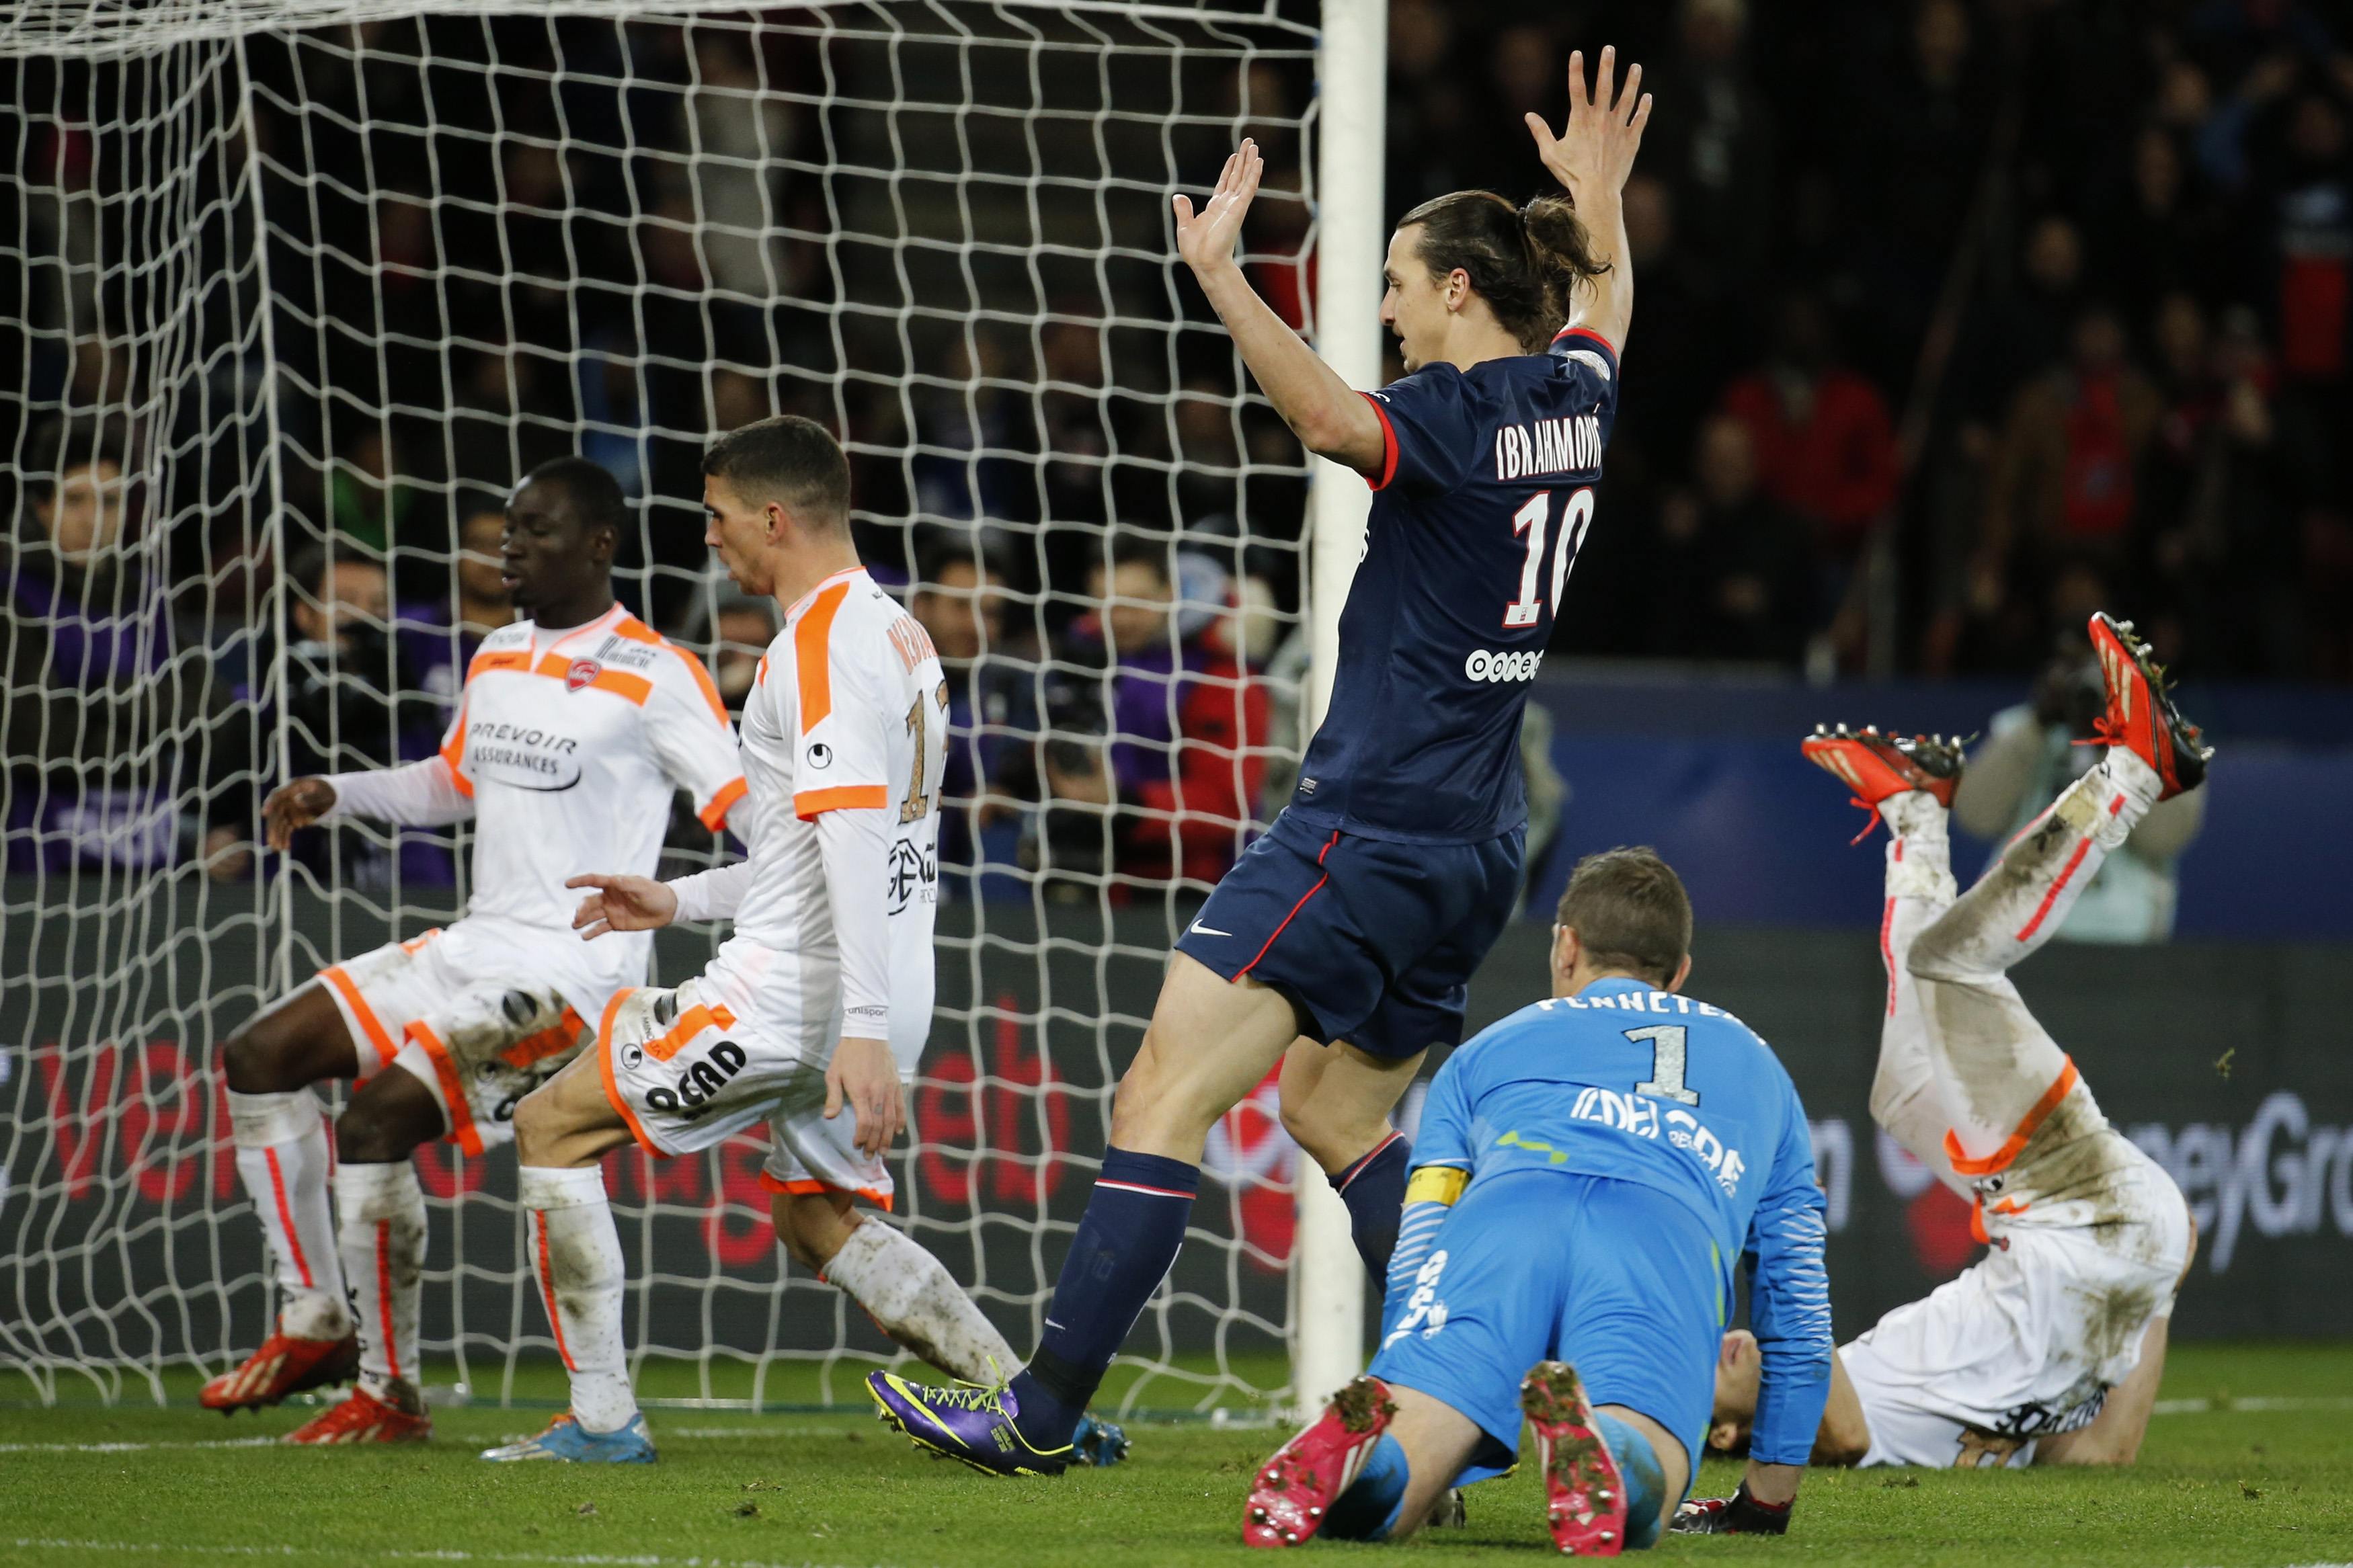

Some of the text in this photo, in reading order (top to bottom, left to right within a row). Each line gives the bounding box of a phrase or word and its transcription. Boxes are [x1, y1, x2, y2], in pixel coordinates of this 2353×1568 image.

[1502, 486, 1595, 629] 10
[472, 745, 559, 774] ASSURANCES
[1621, 1024, 1700, 1108] 1
